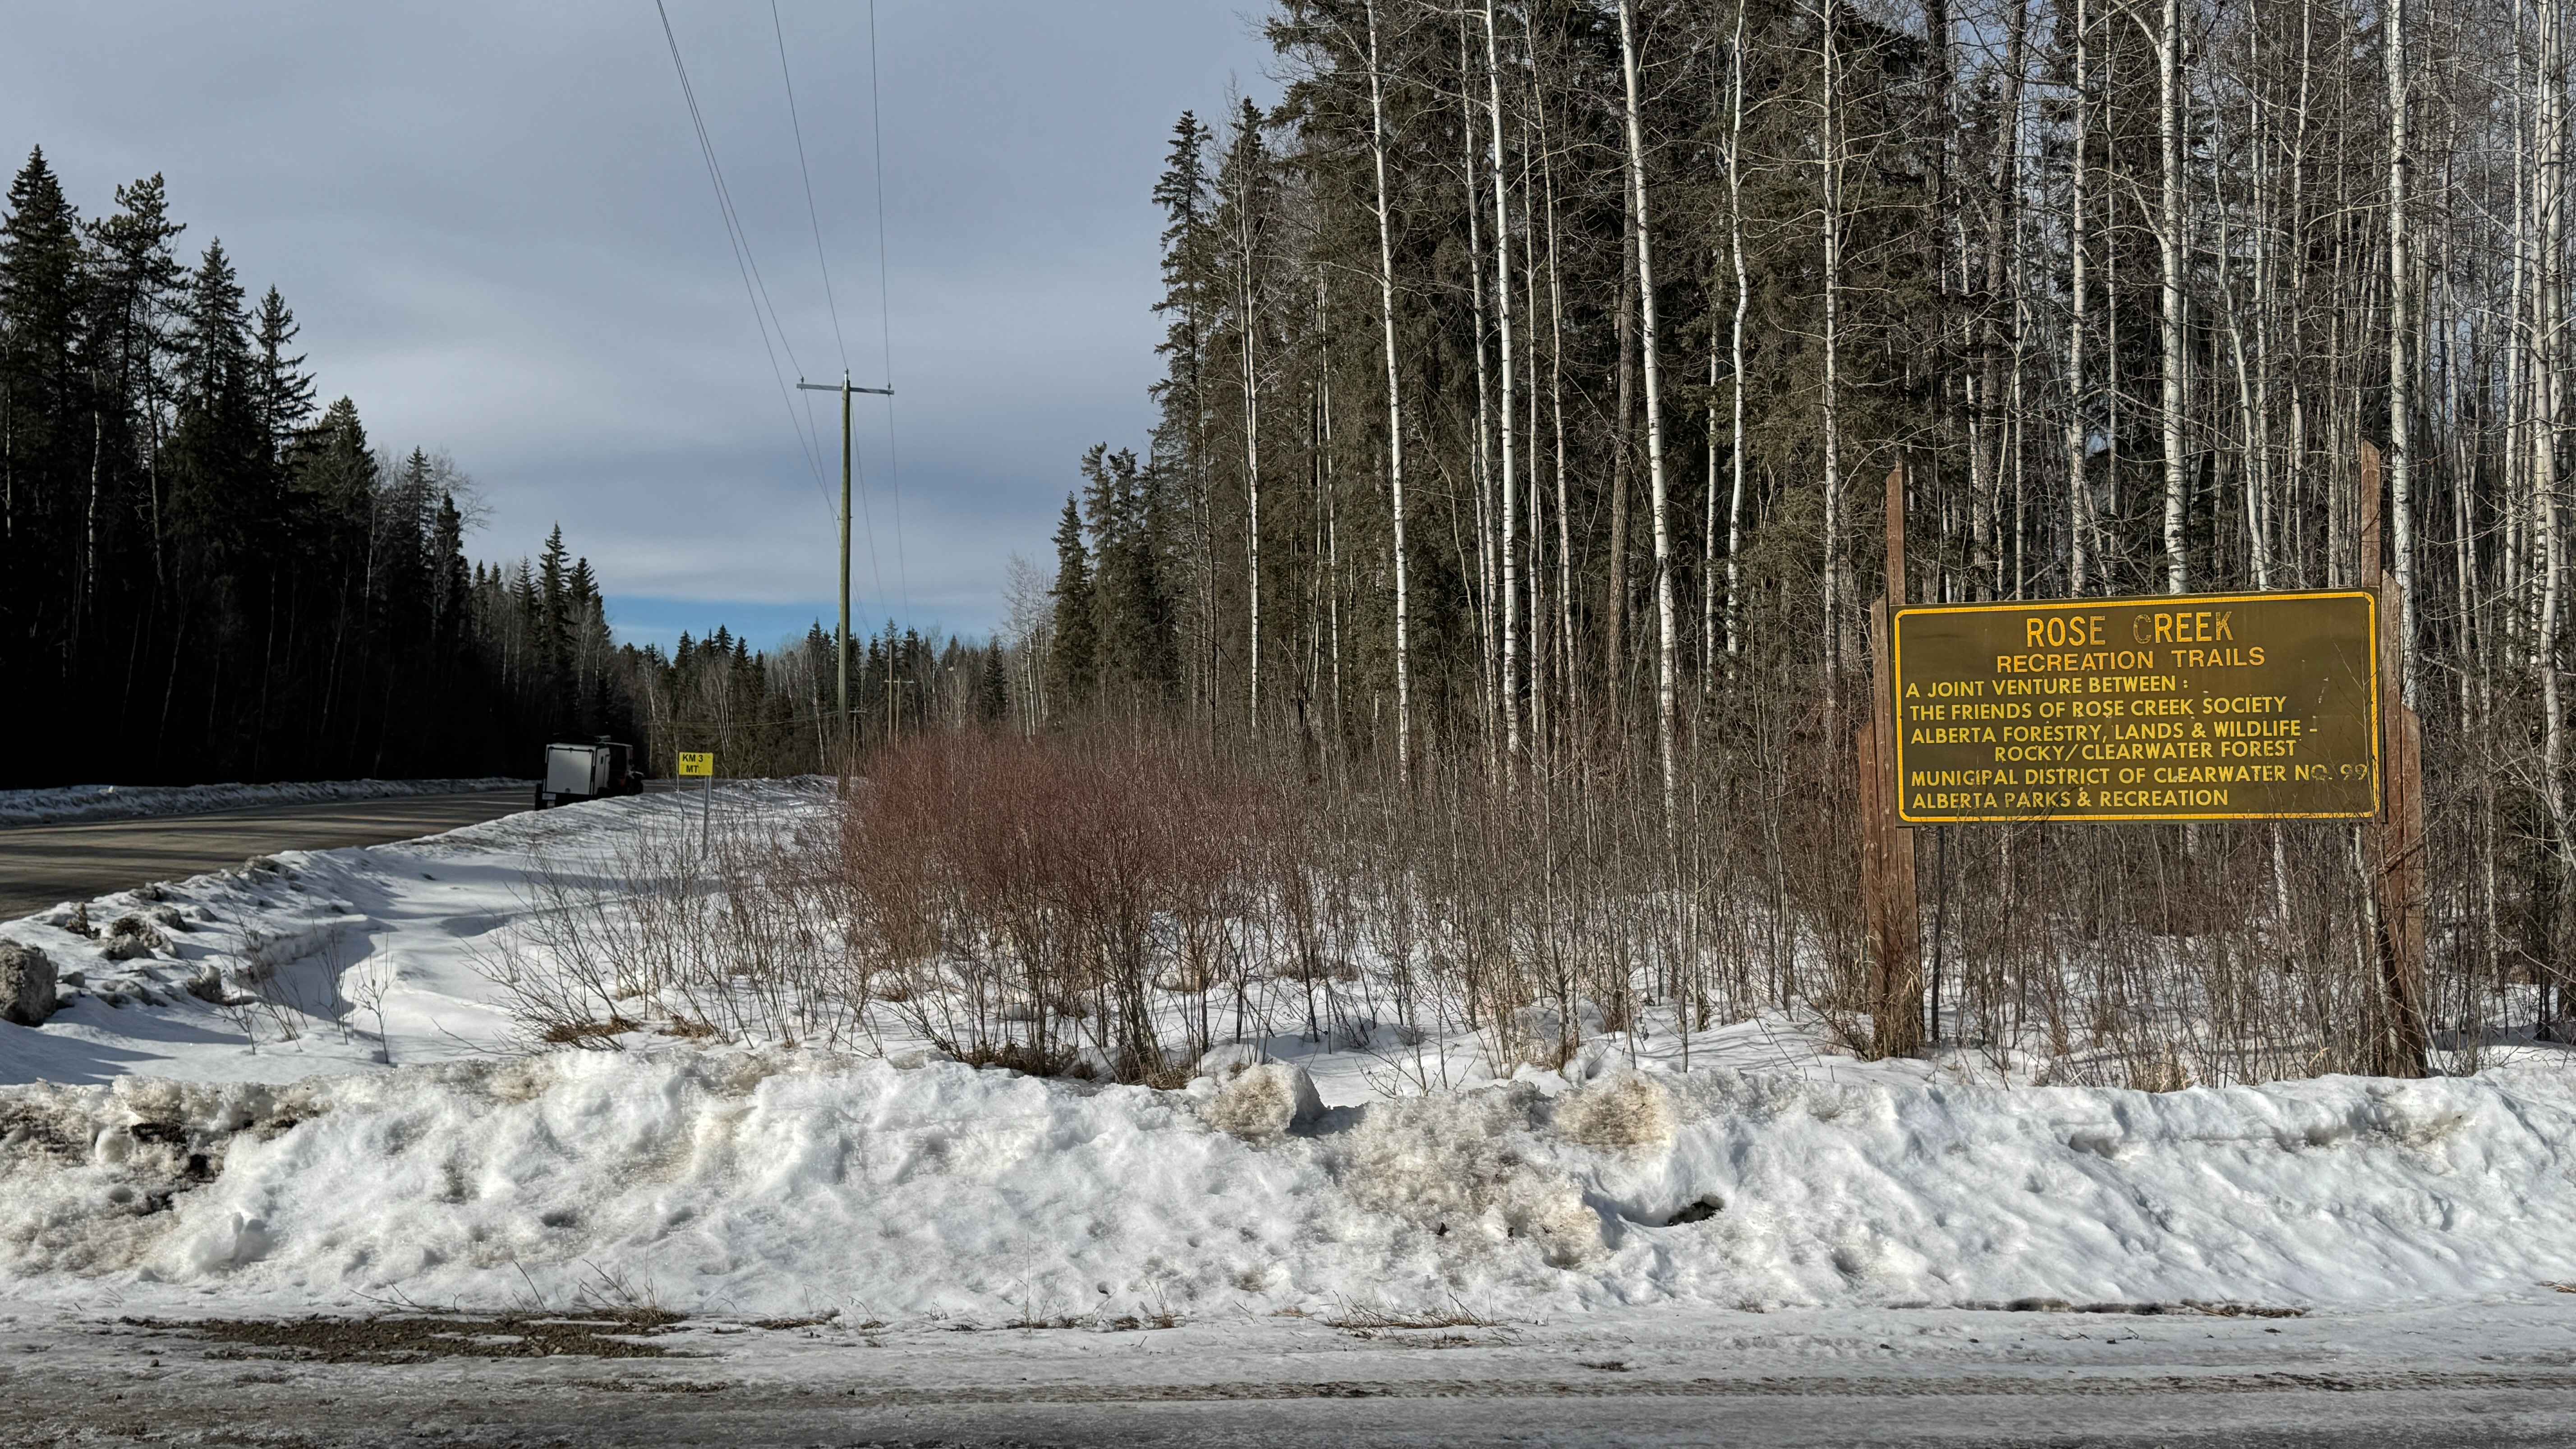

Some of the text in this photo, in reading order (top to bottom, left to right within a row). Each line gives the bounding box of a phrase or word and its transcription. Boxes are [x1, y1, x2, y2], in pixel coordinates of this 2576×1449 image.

[2027, 612, 2233, 647] ROSE CREEK
[1997, 647, 2265, 672] RECREATION TRAILS
[1905, 683, 1920, 697] A
[1927, 681, 1984, 697] JOINT
[1992, 678, 2082, 695] VENTURE
[2089, 676, 2175, 693] BETWEEN
[1910, 696, 2287, 721] THE FRIENDS OF ROSE CREEK SOCIETY
[1911, 727, 1996, 744] ALBERTA
[2004, 725, 2107, 743] FORESTRY,
[2115, 722, 2184, 740] LANDS
[2192, 722, 2207, 738] &
[2214, 720, 2300, 737] WILDLIFE
[682, 754, 704, 762] KM 3
[1995, 740, 2296, 761] ROCKY/CLEARWATER FOREST
[686, 765, 699, 773] MT
[1911, 769, 2018, 786] MUNICIPAL
[2025, 768, 2110, 785] DISTRICT
[2119, 768, 2145, 784] OF
[2154, 765, 2286, 783] CLEARWATER
[2340, 764, 2367, 780] 99
[1913, 790, 2228, 809] ALBERTA PARKS & RECREATION
